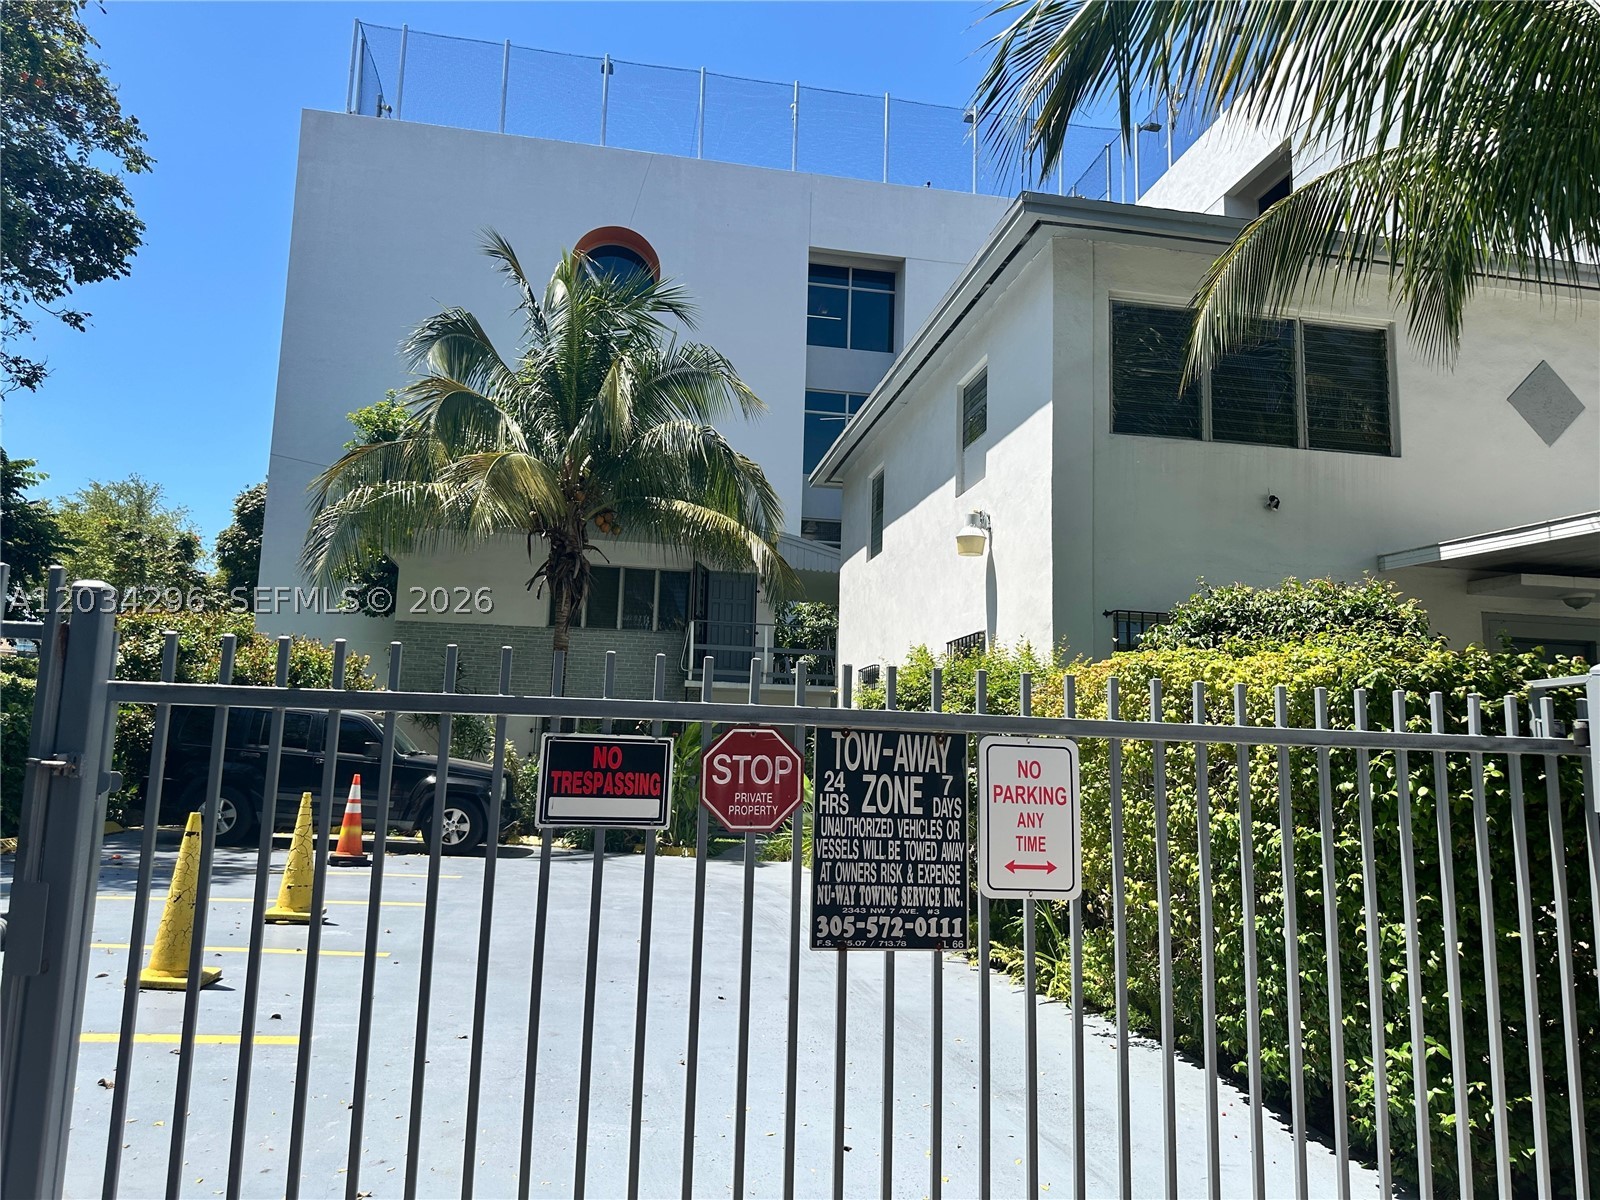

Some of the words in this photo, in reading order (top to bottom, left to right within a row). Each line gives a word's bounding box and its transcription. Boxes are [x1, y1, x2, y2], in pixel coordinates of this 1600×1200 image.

[593, 746, 623, 769] NO
[831, 730, 952, 774] TOW-AWAY
[711, 753, 793, 785] STOP
[1017, 760, 1041, 779] NO
[551, 771, 661, 796] TRESPASSING
[823, 770, 846, 793] 24
[941, 775, 954, 796] 7
[734, 792, 773, 804] PRIVATE
[819, 793, 849, 815] HRS
[861, 773, 924, 815] ZONE
[993, 784, 1067, 806] PARKING
[728, 805, 779, 816] PROPERTY
[932, 797, 962, 819] DAYS
[820, 816, 894, 838] UNAUTHORIZED
[897, 818, 943, 839] VEHICLES
[946, 820, 961, 840] OR
[1017, 812, 1044, 828] ANY
[816, 838, 859, 860] VESSELS
[862, 840, 886, 860] WILL
[888, 841, 901, 861] BE
[904, 841, 938, 862] TOWED
[940, 842, 965, 862] AWAY
[1015, 836, 1046, 852] TIME
[820, 861, 832, 882] AT
[835, 862, 877, 883] OWNERS
[880, 863, 903, 884] RISK
[906, 864, 914, 884] &
[917, 864, 961, 885] EXPENSE
[817, 885, 856, 905] NU-WAY
[859, 886, 898, 906] TOWING
[901, 887, 941, 907] SERVICE
[944, 887, 964, 907] INC.
[816, 915, 964, 939] 305-572-0111
[816, 939, 834, 947] F.S.
[952, 940, 964, 948] 66
